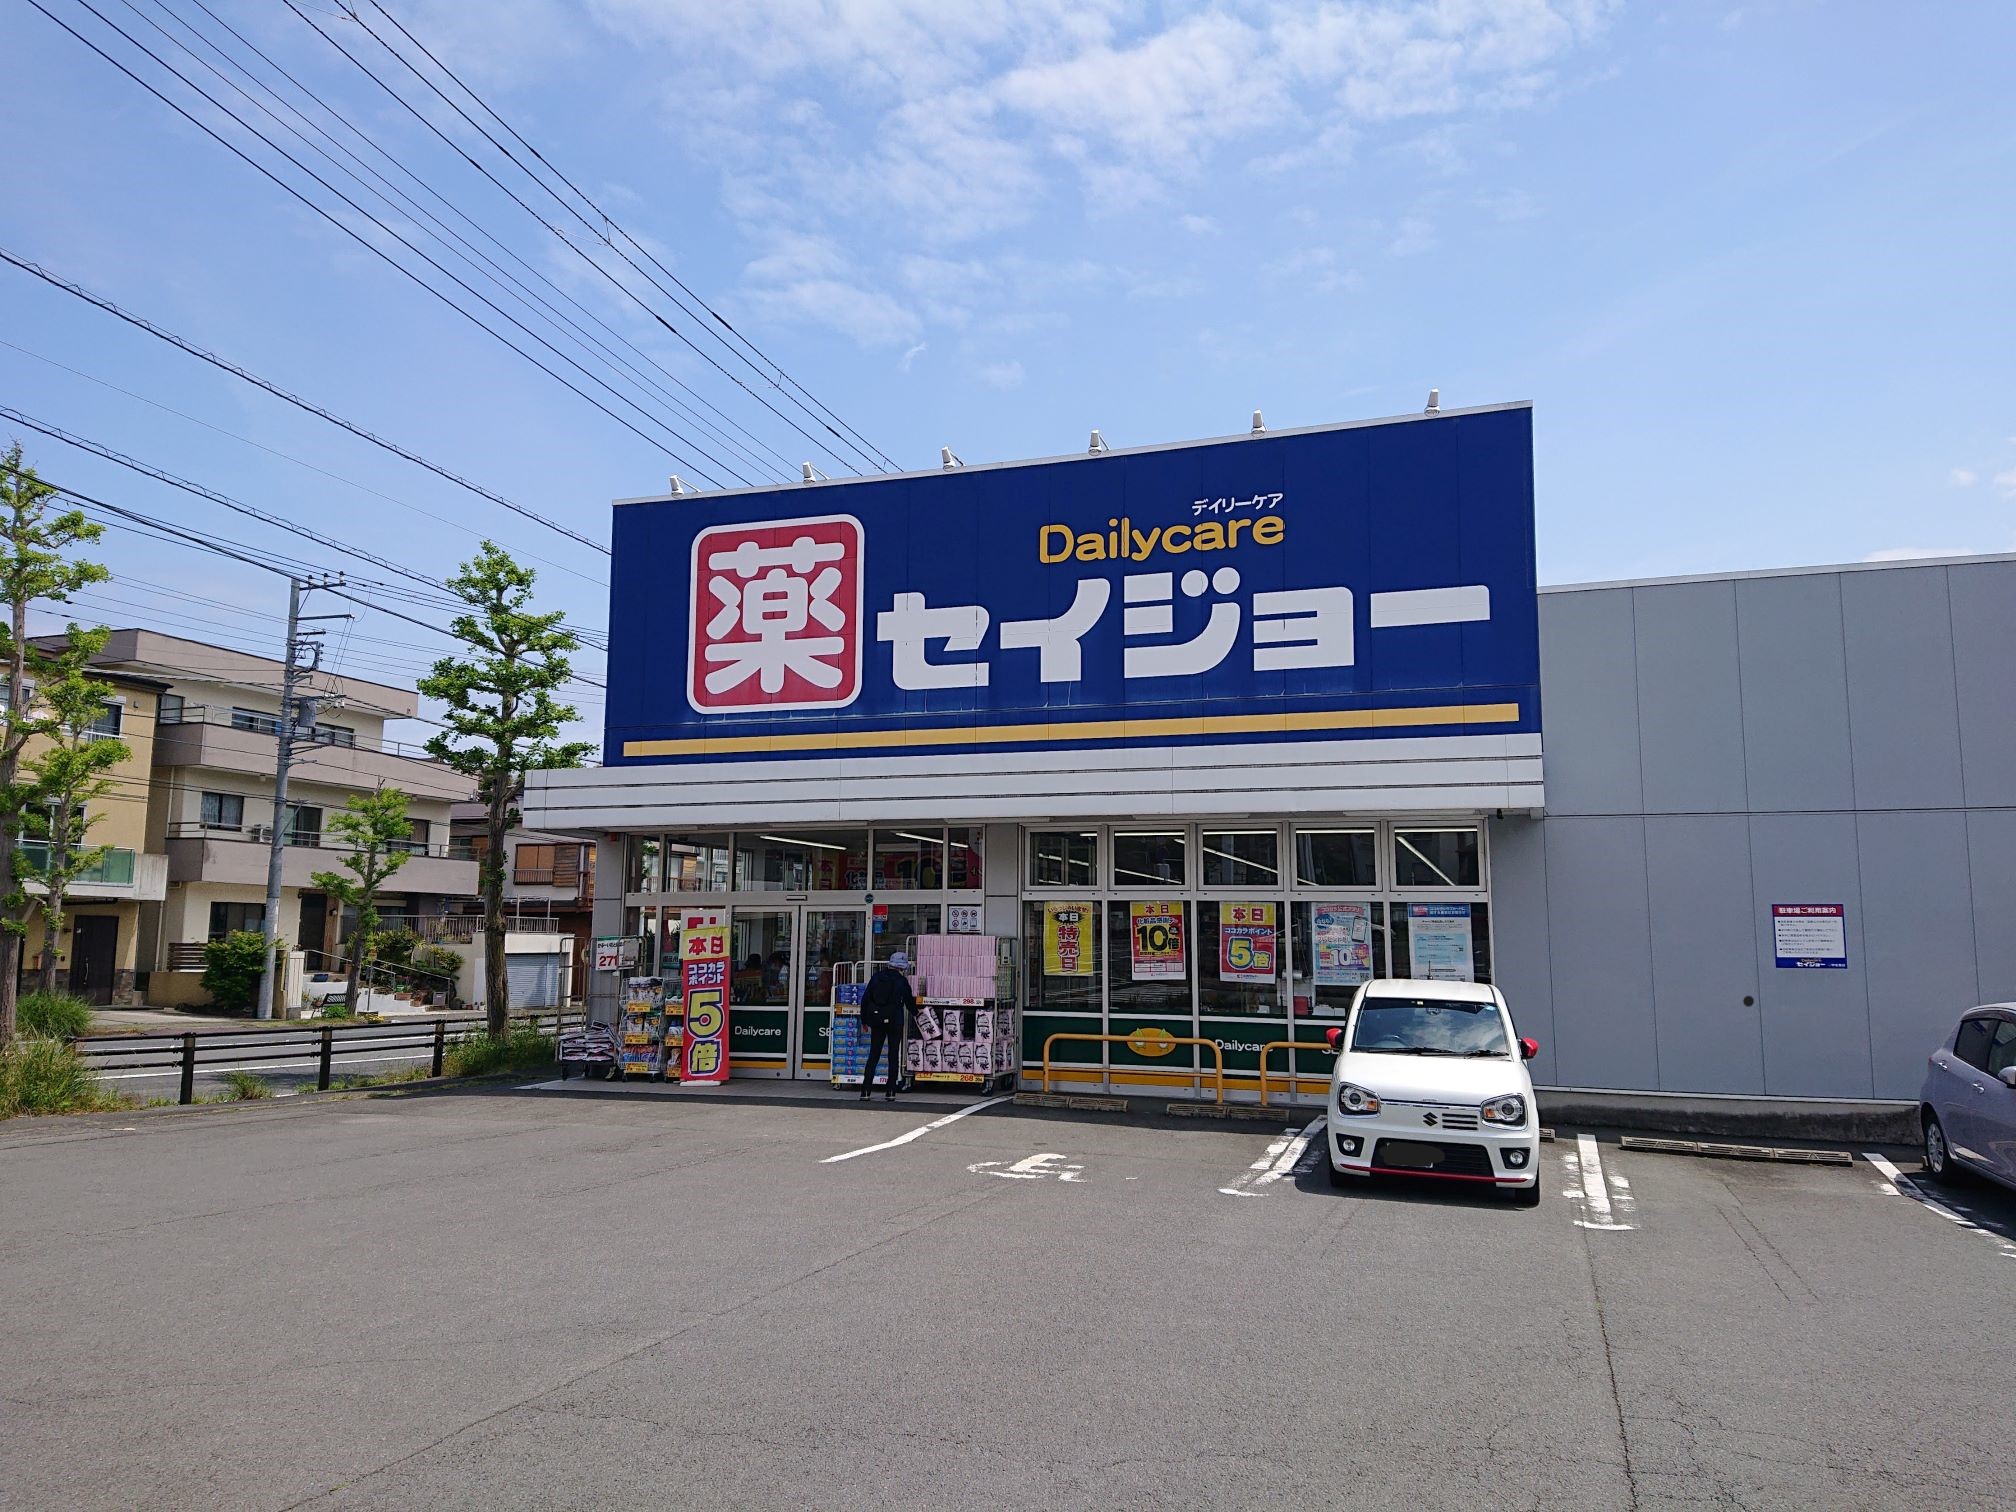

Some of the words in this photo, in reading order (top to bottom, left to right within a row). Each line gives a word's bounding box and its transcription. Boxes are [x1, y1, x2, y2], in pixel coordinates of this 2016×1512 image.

[1192, 492, 1284, 517] デイリーケア
[1039, 513, 1285, 563] Dailycare
[704, 536, 846, 694] 薬
[877, 566, 1491, 691] セイジョー
[1145, 904, 1169, 914] 本日
[1232, 907, 1264, 921] 本日
[1058, 912, 1079, 922] 本日
[1224, 927, 1273, 935] ココカラポイント
[688, 936, 724, 955] 本日
[1058, 926, 1079, 971] 特売日
[599, 955, 619, 967] 271
[687, 961, 725, 975] ココカラ
[687, 972, 725, 986] ポイント
[734, 1026, 782, 1036] Dailycare
[1214, 1038, 1274, 1052] Dailycar
